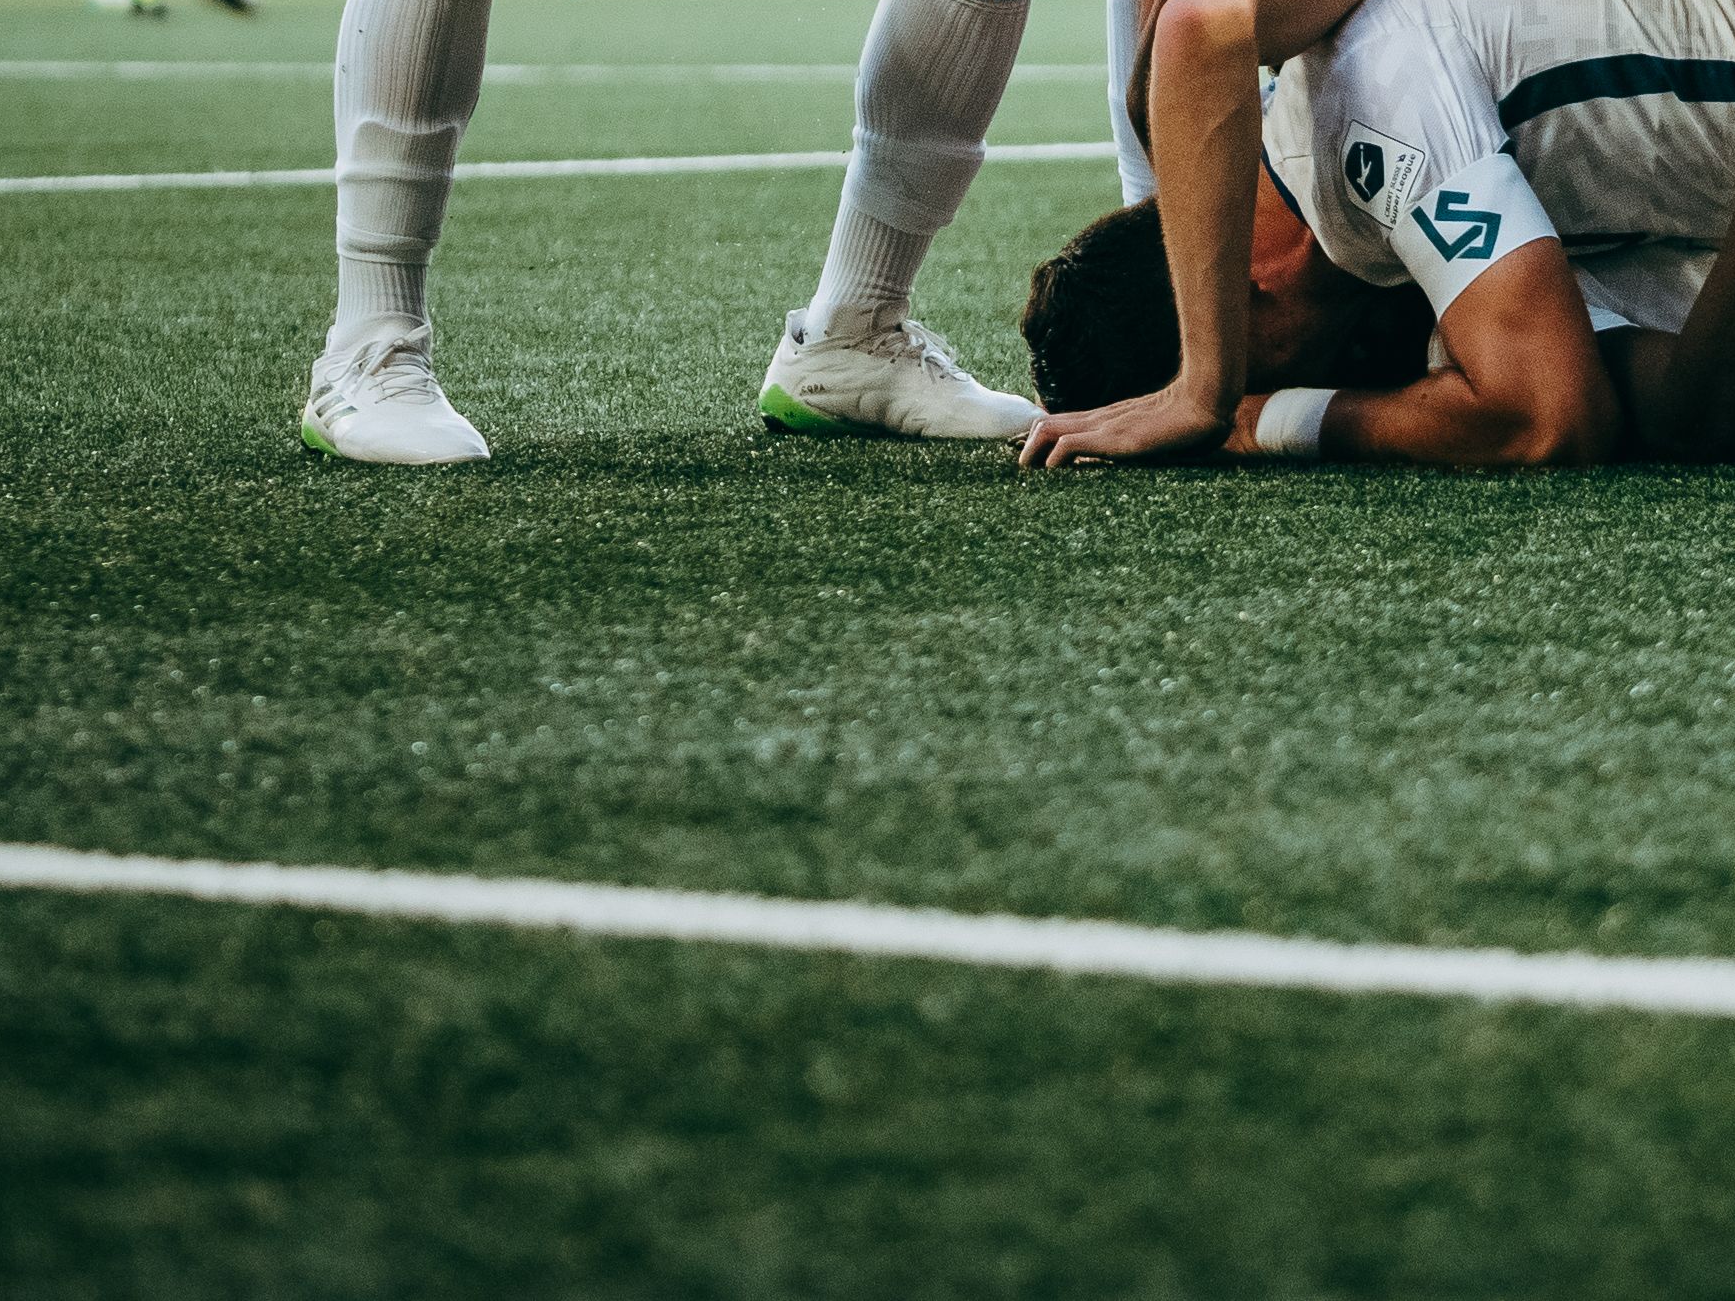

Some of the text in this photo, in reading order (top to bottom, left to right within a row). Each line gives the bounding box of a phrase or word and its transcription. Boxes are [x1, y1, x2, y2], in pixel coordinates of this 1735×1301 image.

[1384, 189, 1395, 218] CREDIT
[1389, 152, 1417, 226] Super League
